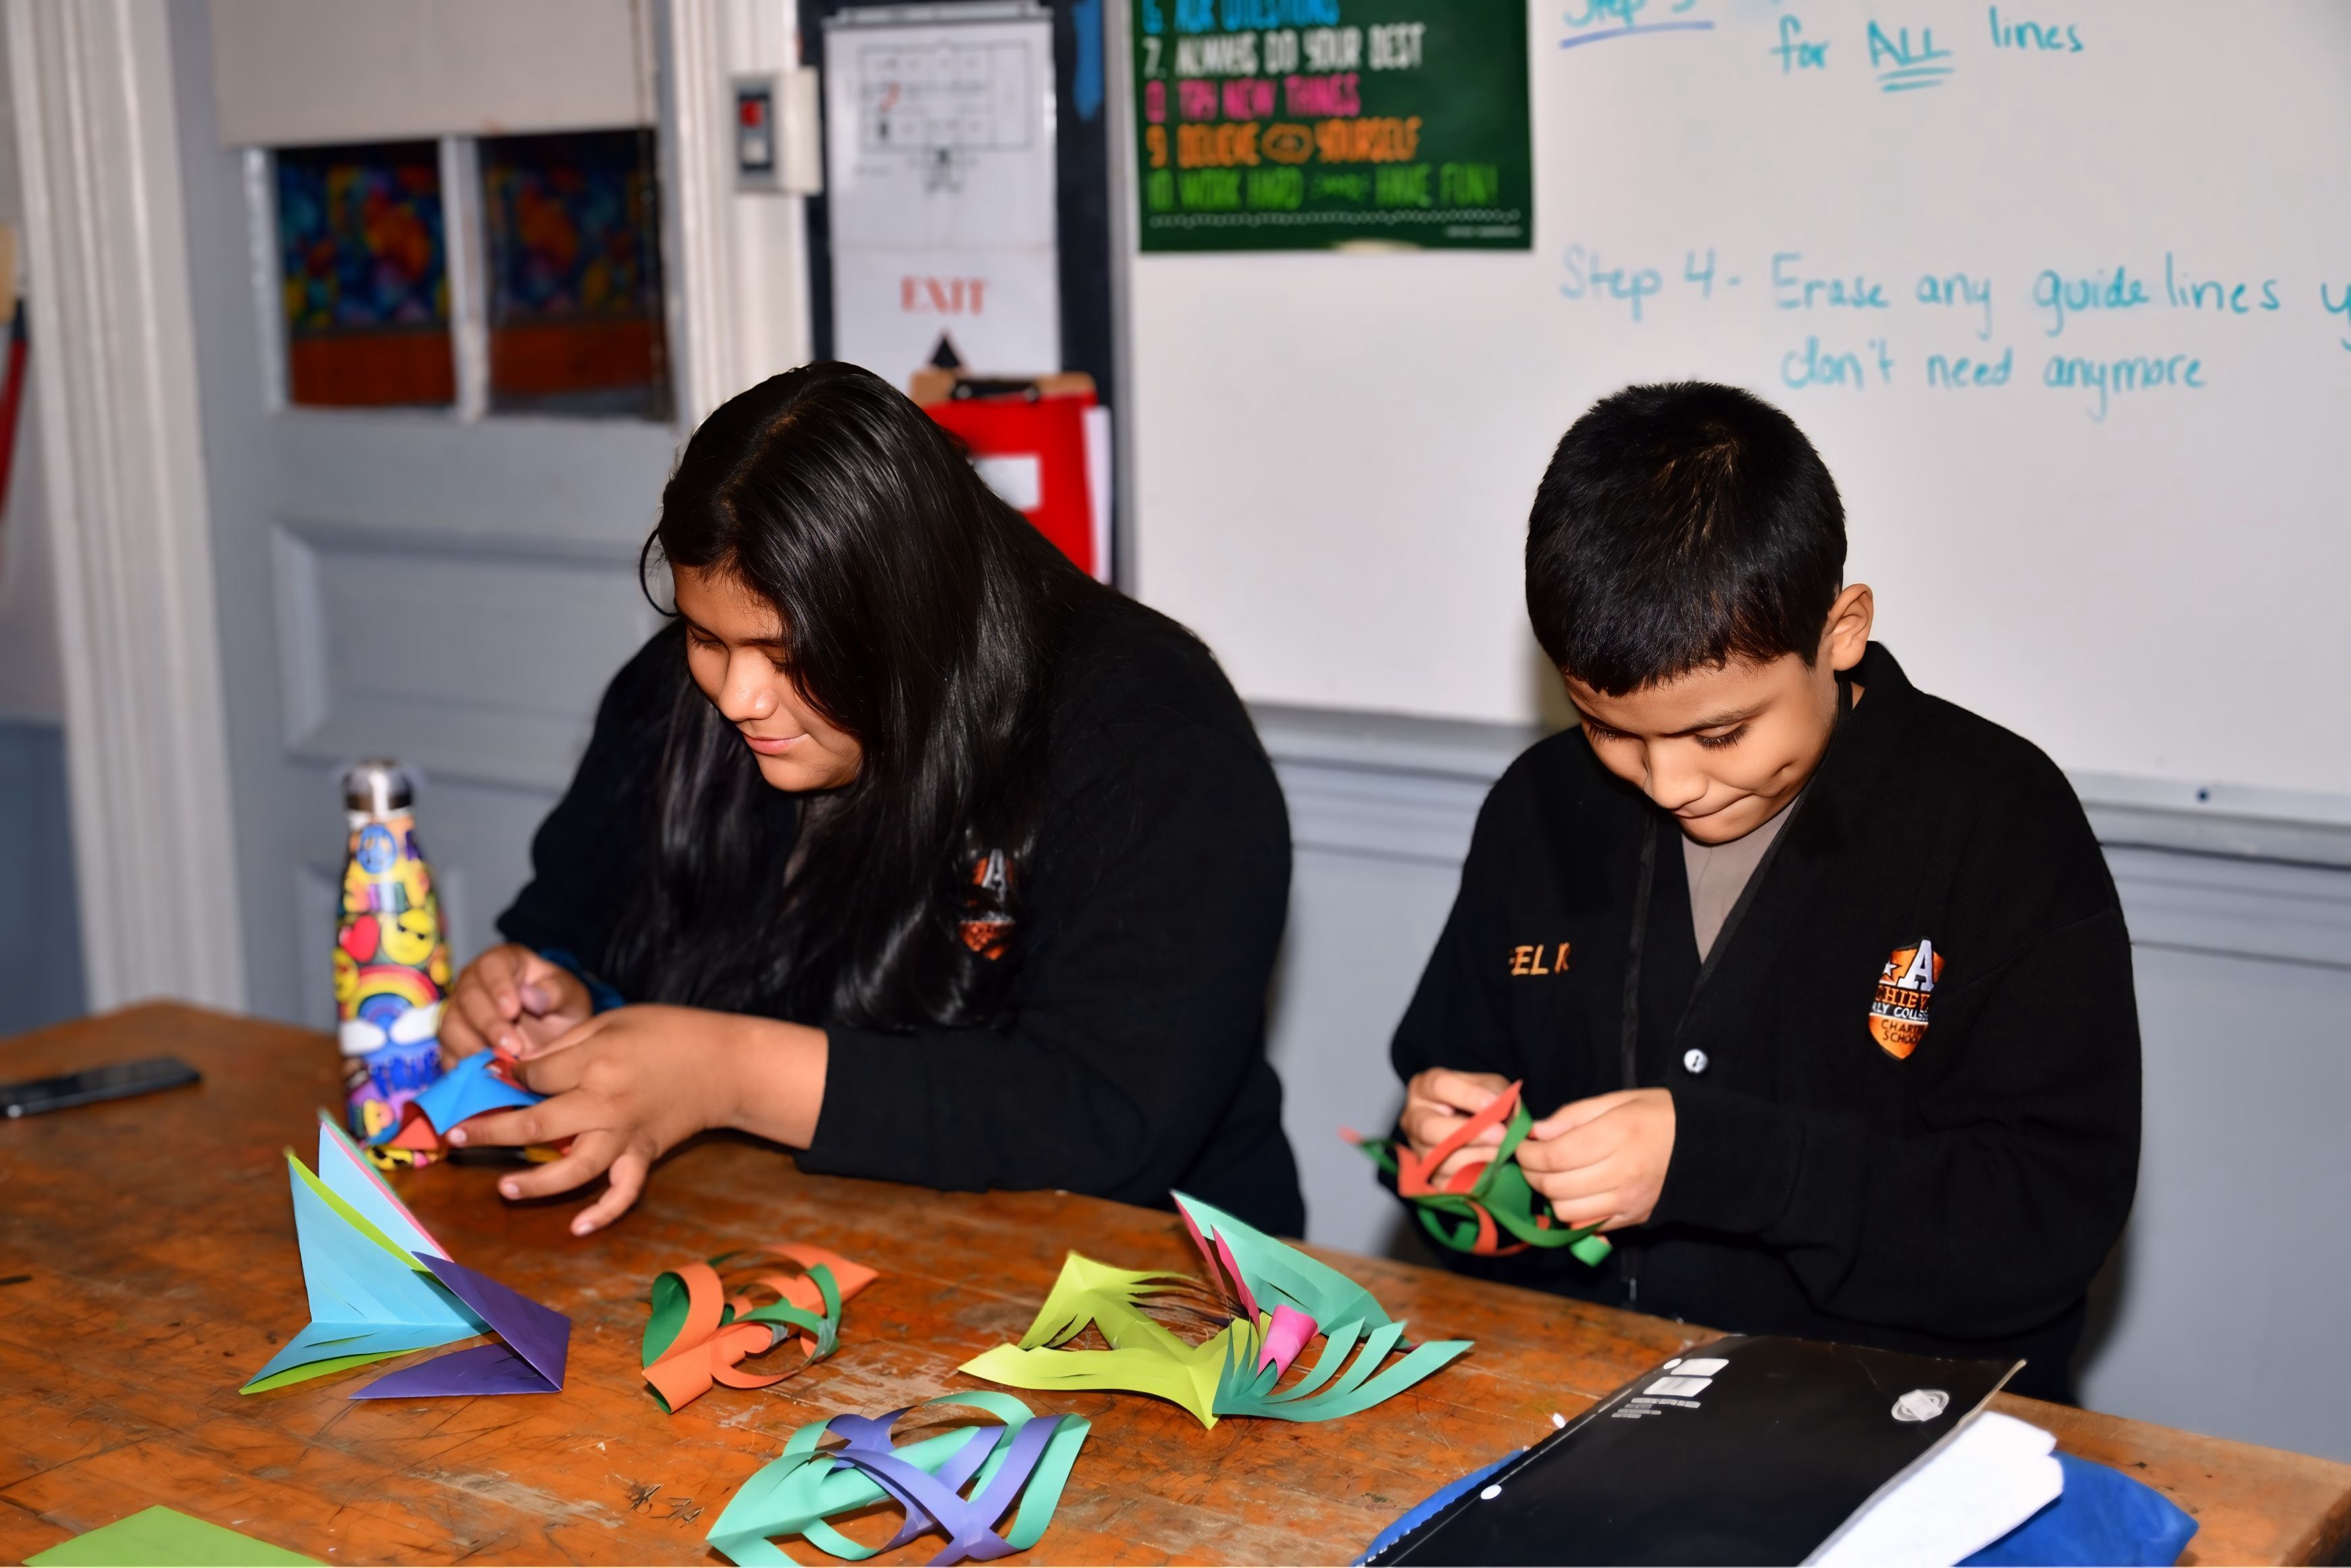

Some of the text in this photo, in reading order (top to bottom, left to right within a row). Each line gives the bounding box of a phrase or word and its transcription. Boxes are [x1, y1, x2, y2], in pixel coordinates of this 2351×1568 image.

[1175, 32, 1258, 76] ALWAYS
[1265, 30, 1298, 74] DO
[1303, 26, 1361, 70] YOUR
[1369, 23, 1424, 68] BEST
[1769, 5, 2083, 74] for ALL lines
[1222, 77, 1276, 118] NEW
[1286, 73, 1360, 117] THINGS
[1315, 117, 1422, 163] YOURSELF
[900, 274, 988, 315] EXIT
[1559, 242, 1663, 322] Step
[1771, 251, 1891, 310] Erase
[1915, 272, 1993, 341] any
[1780, 334, 2207, 424] don't need anymore
[1896, 938, 1935, 992] A
